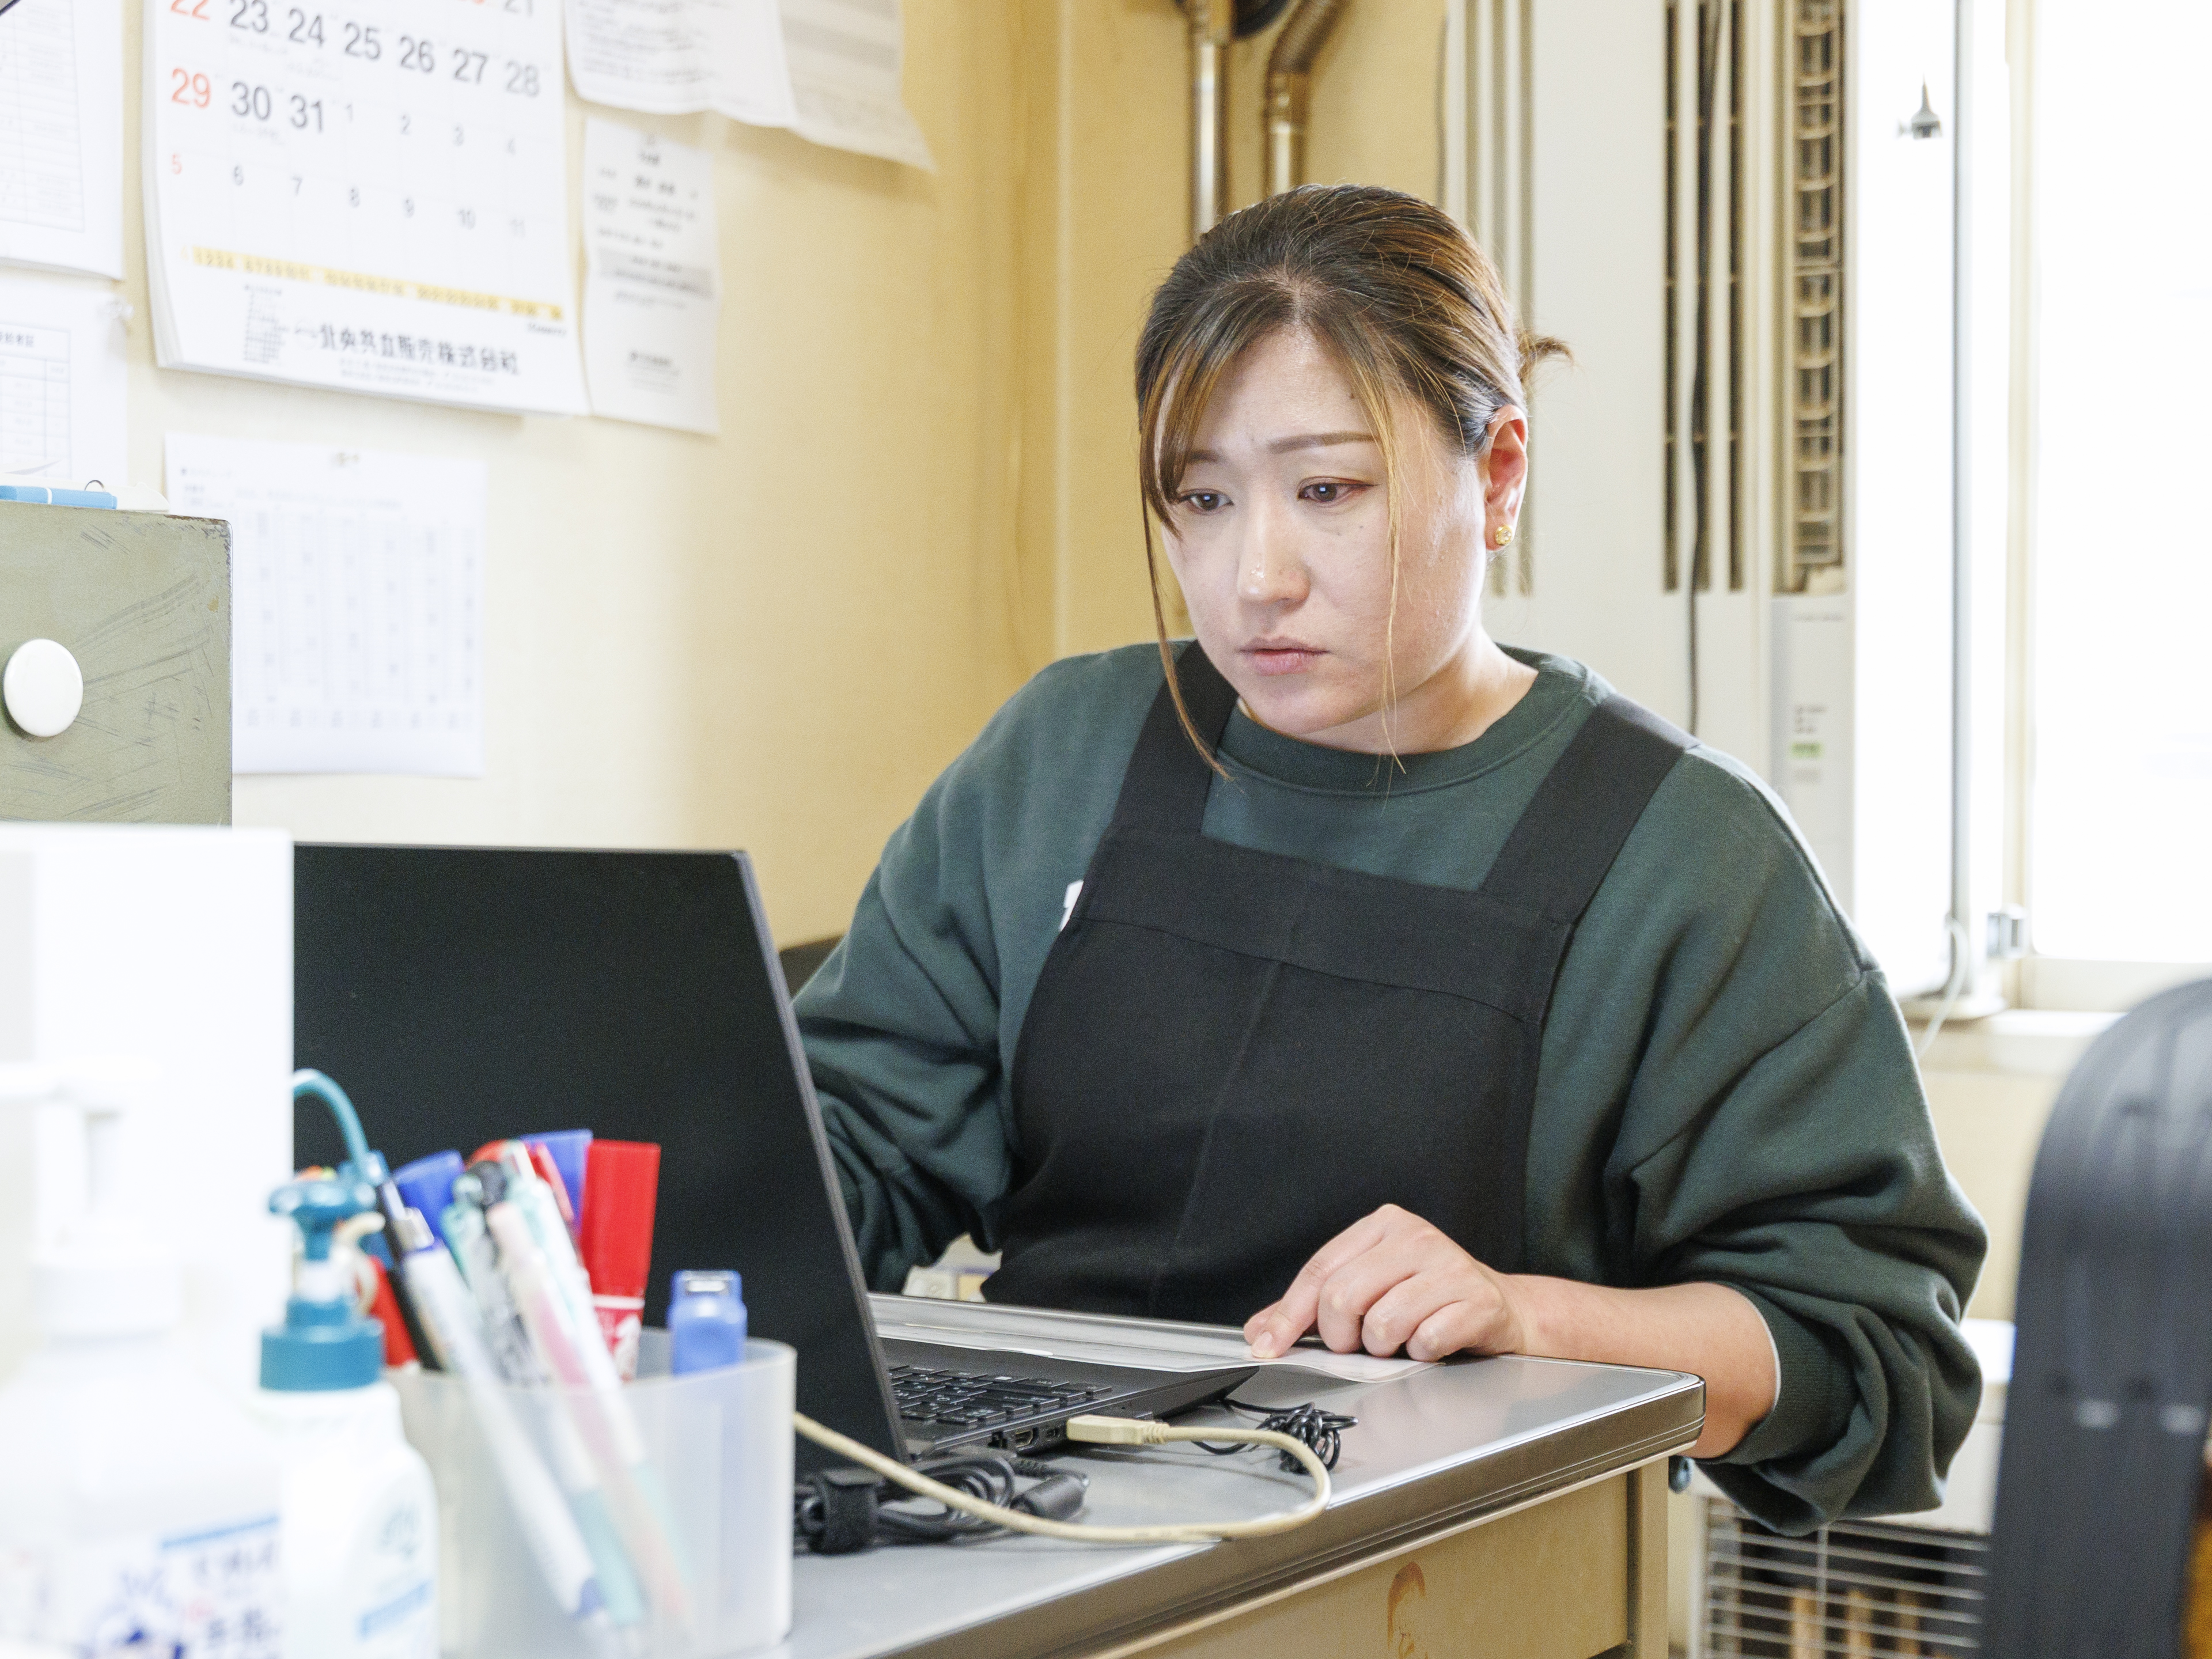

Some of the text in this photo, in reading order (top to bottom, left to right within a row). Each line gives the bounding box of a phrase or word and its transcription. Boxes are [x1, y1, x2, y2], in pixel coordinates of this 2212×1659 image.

[229, 0, 269, 34] 23
[288, 7, 325, 47] 24
[344, 21, 382, 61] 25
[399, 35, 435, 74] 26
[453, 47, 489, 84] 27
[505, 59, 540, 98] 28
[171, 67, 211, 108] 29
[231, 81, 272, 122] 30
[290, 94, 323, 132] 31
[344, 103, 353, 121] 1
[400, 114, 411, 135] 2
[453, 124, 464, 147] 3
[171, 153, 183, 175] 5
[232, 165, 244, 186] 6
[291, 175, 304, 196] 7
[349, 187, 360, 207] 8
[403, 197, 415, 218] 9
[457, 208, 476, 229] 10
